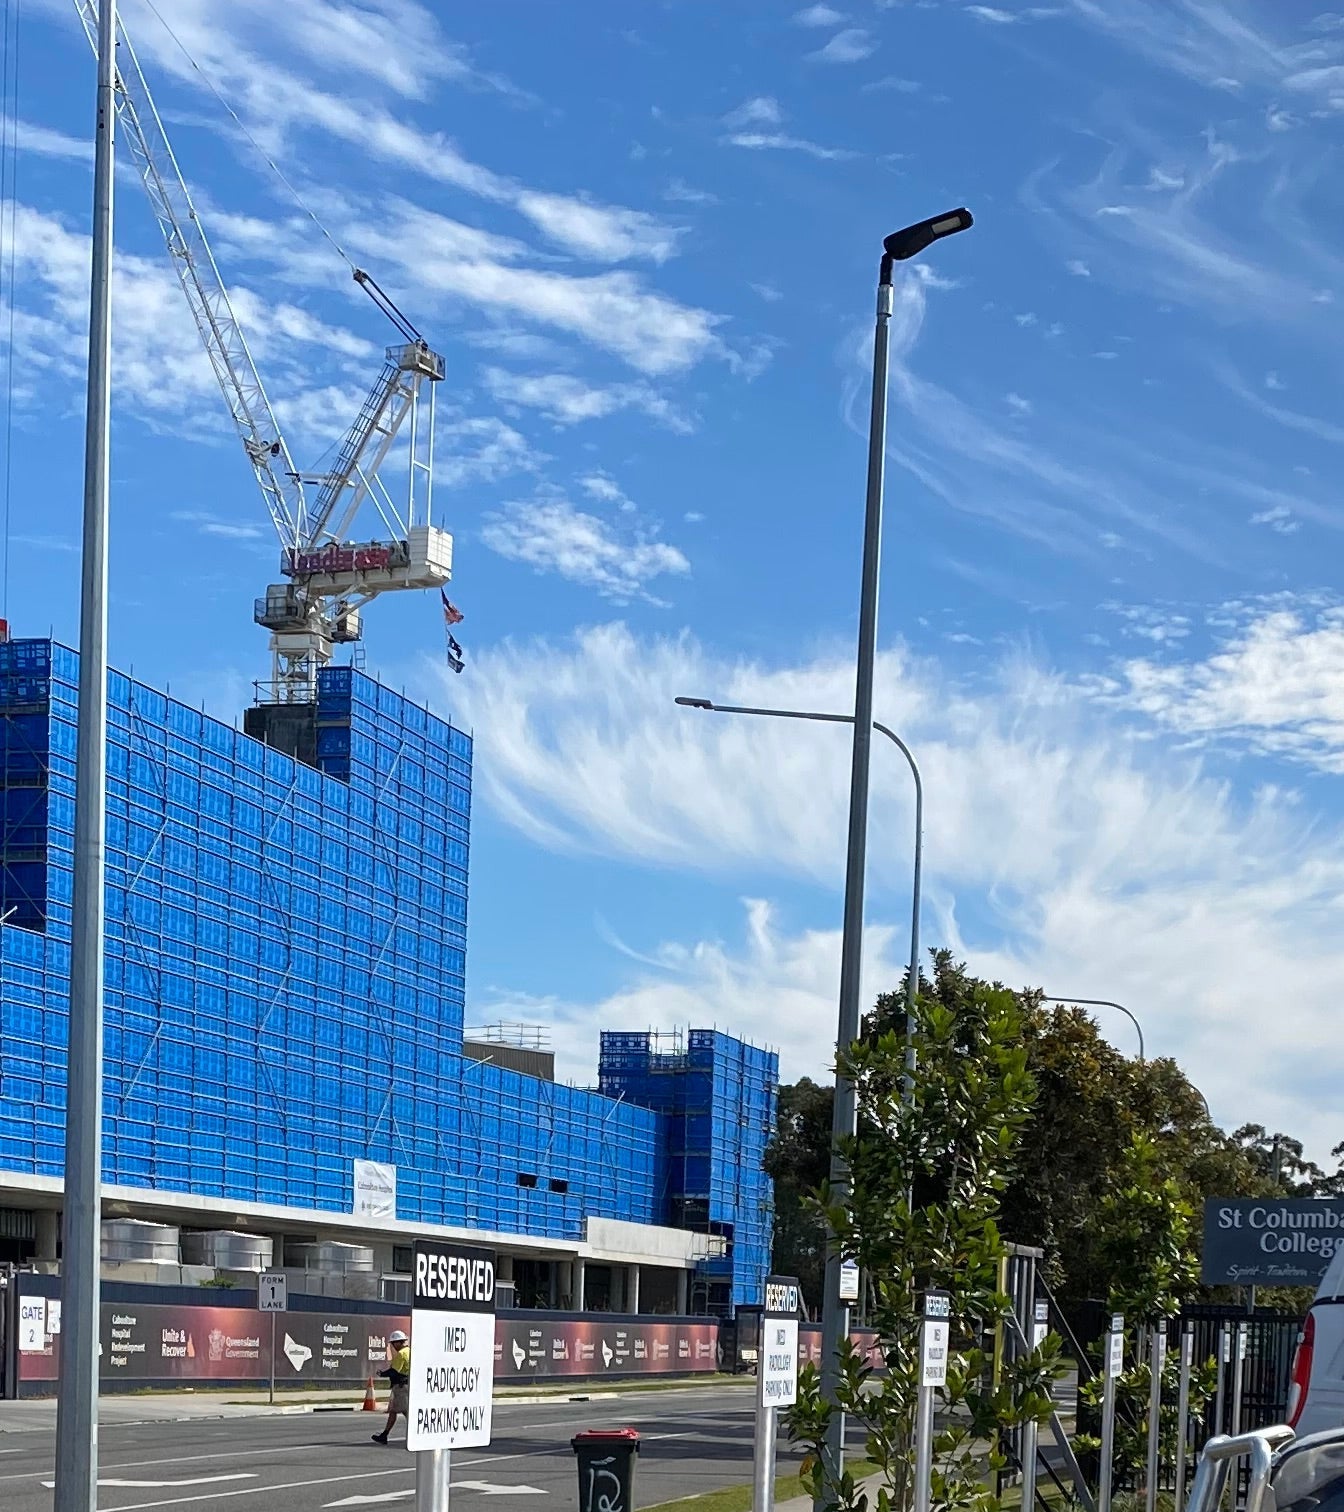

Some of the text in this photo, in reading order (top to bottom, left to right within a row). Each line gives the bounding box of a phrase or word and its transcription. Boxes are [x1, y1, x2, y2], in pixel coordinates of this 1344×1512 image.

[1218, 1207, 1243, 1228] St
[262, 1276, 284, 1284] FORM
[416, 1253, 494, 1302] RESERVED
[270, 1286, 274, 1298] 1
[766, 1284, 798, 1312] RESERVED
[22, 1306, 43, 1320] GATE
[30, 1329, 34, 1342] 2
[444, 1327, 466, 1352] IMED
[426, 1367, 480, 1393] RADIOLOGY
[417, 1406, 485, 1434] PARKING ONLY
